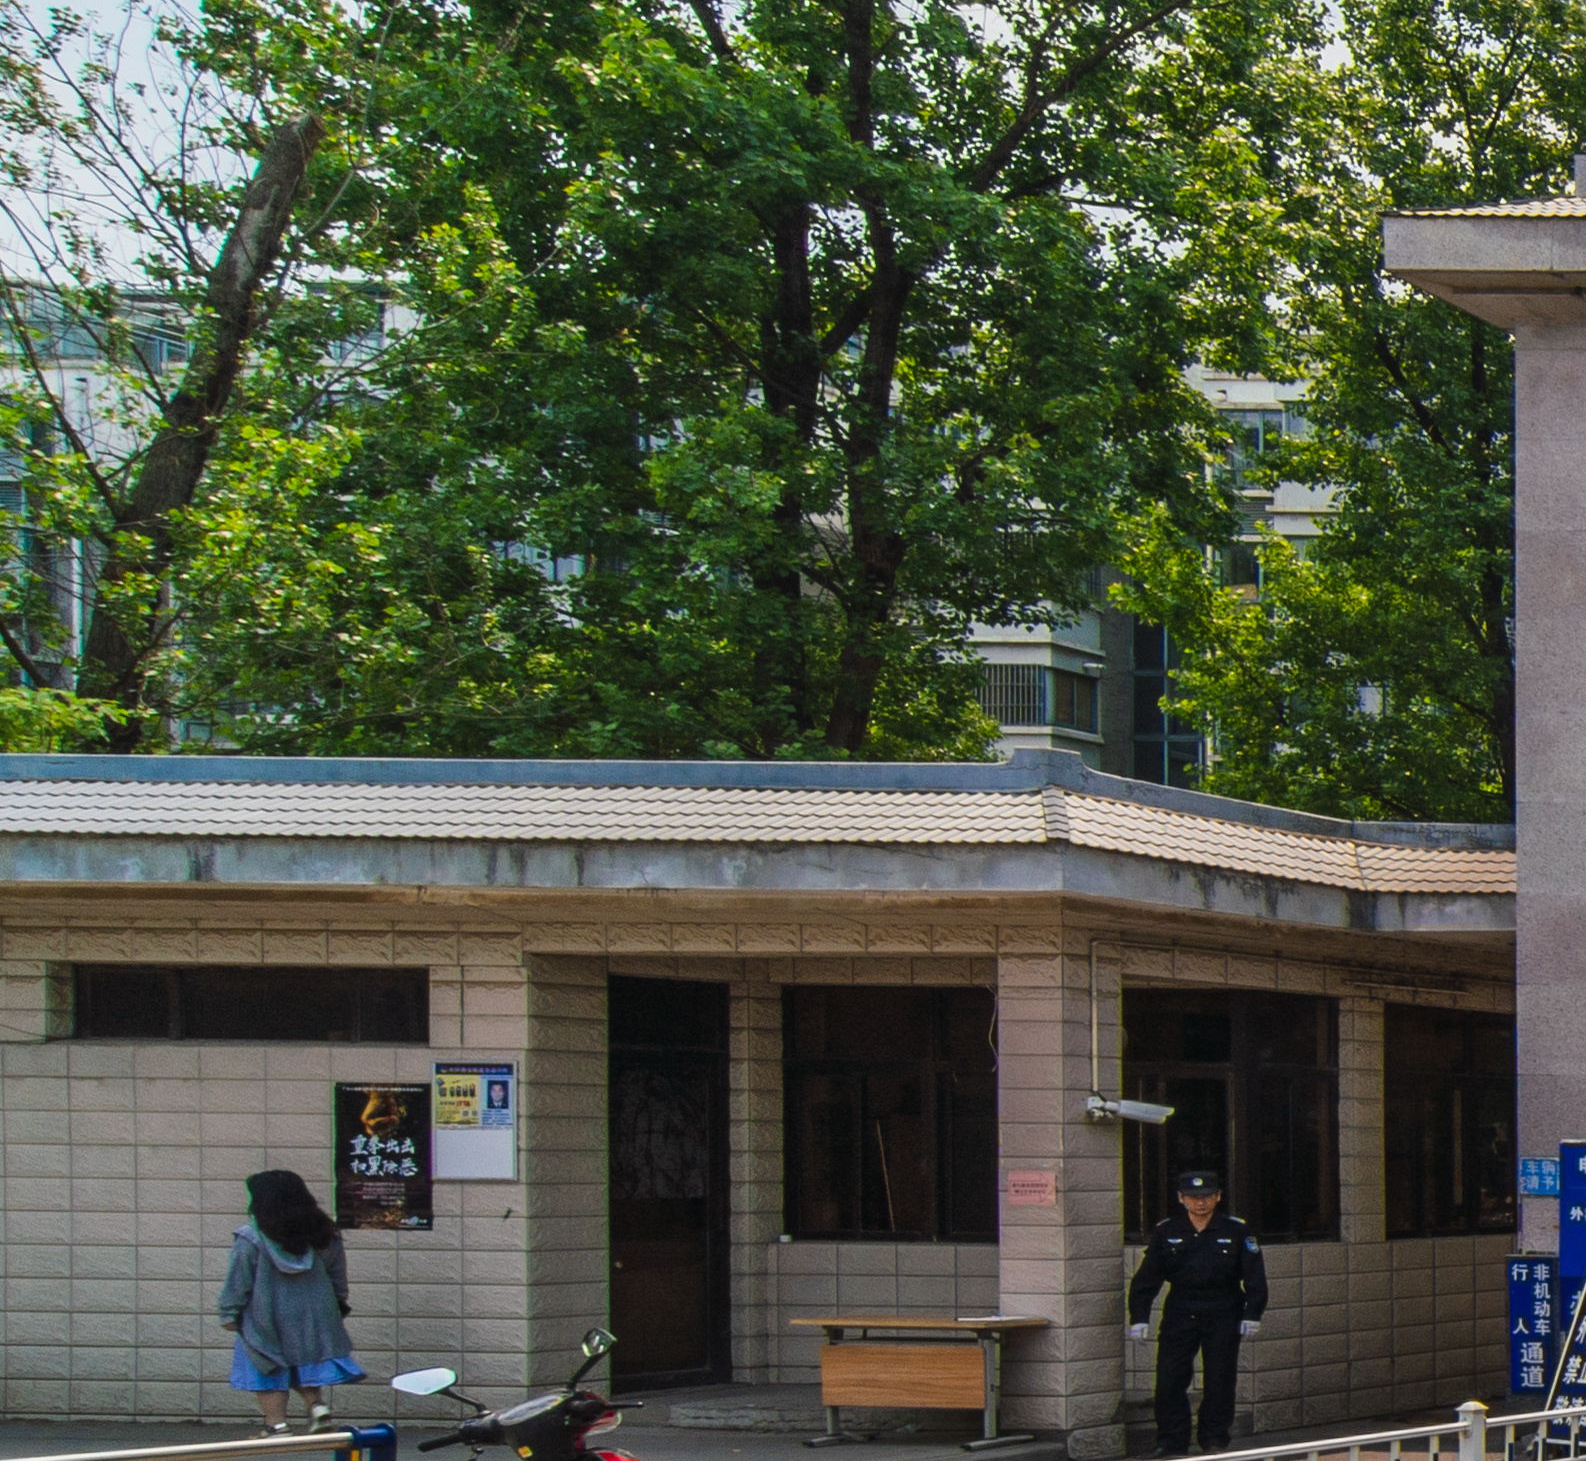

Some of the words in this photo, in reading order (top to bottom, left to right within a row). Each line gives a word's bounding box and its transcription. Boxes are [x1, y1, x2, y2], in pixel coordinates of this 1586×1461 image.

[1533, 1264, 1551, 1336] 非机动车
[1520, 1342, 1545, 1388] 通道
